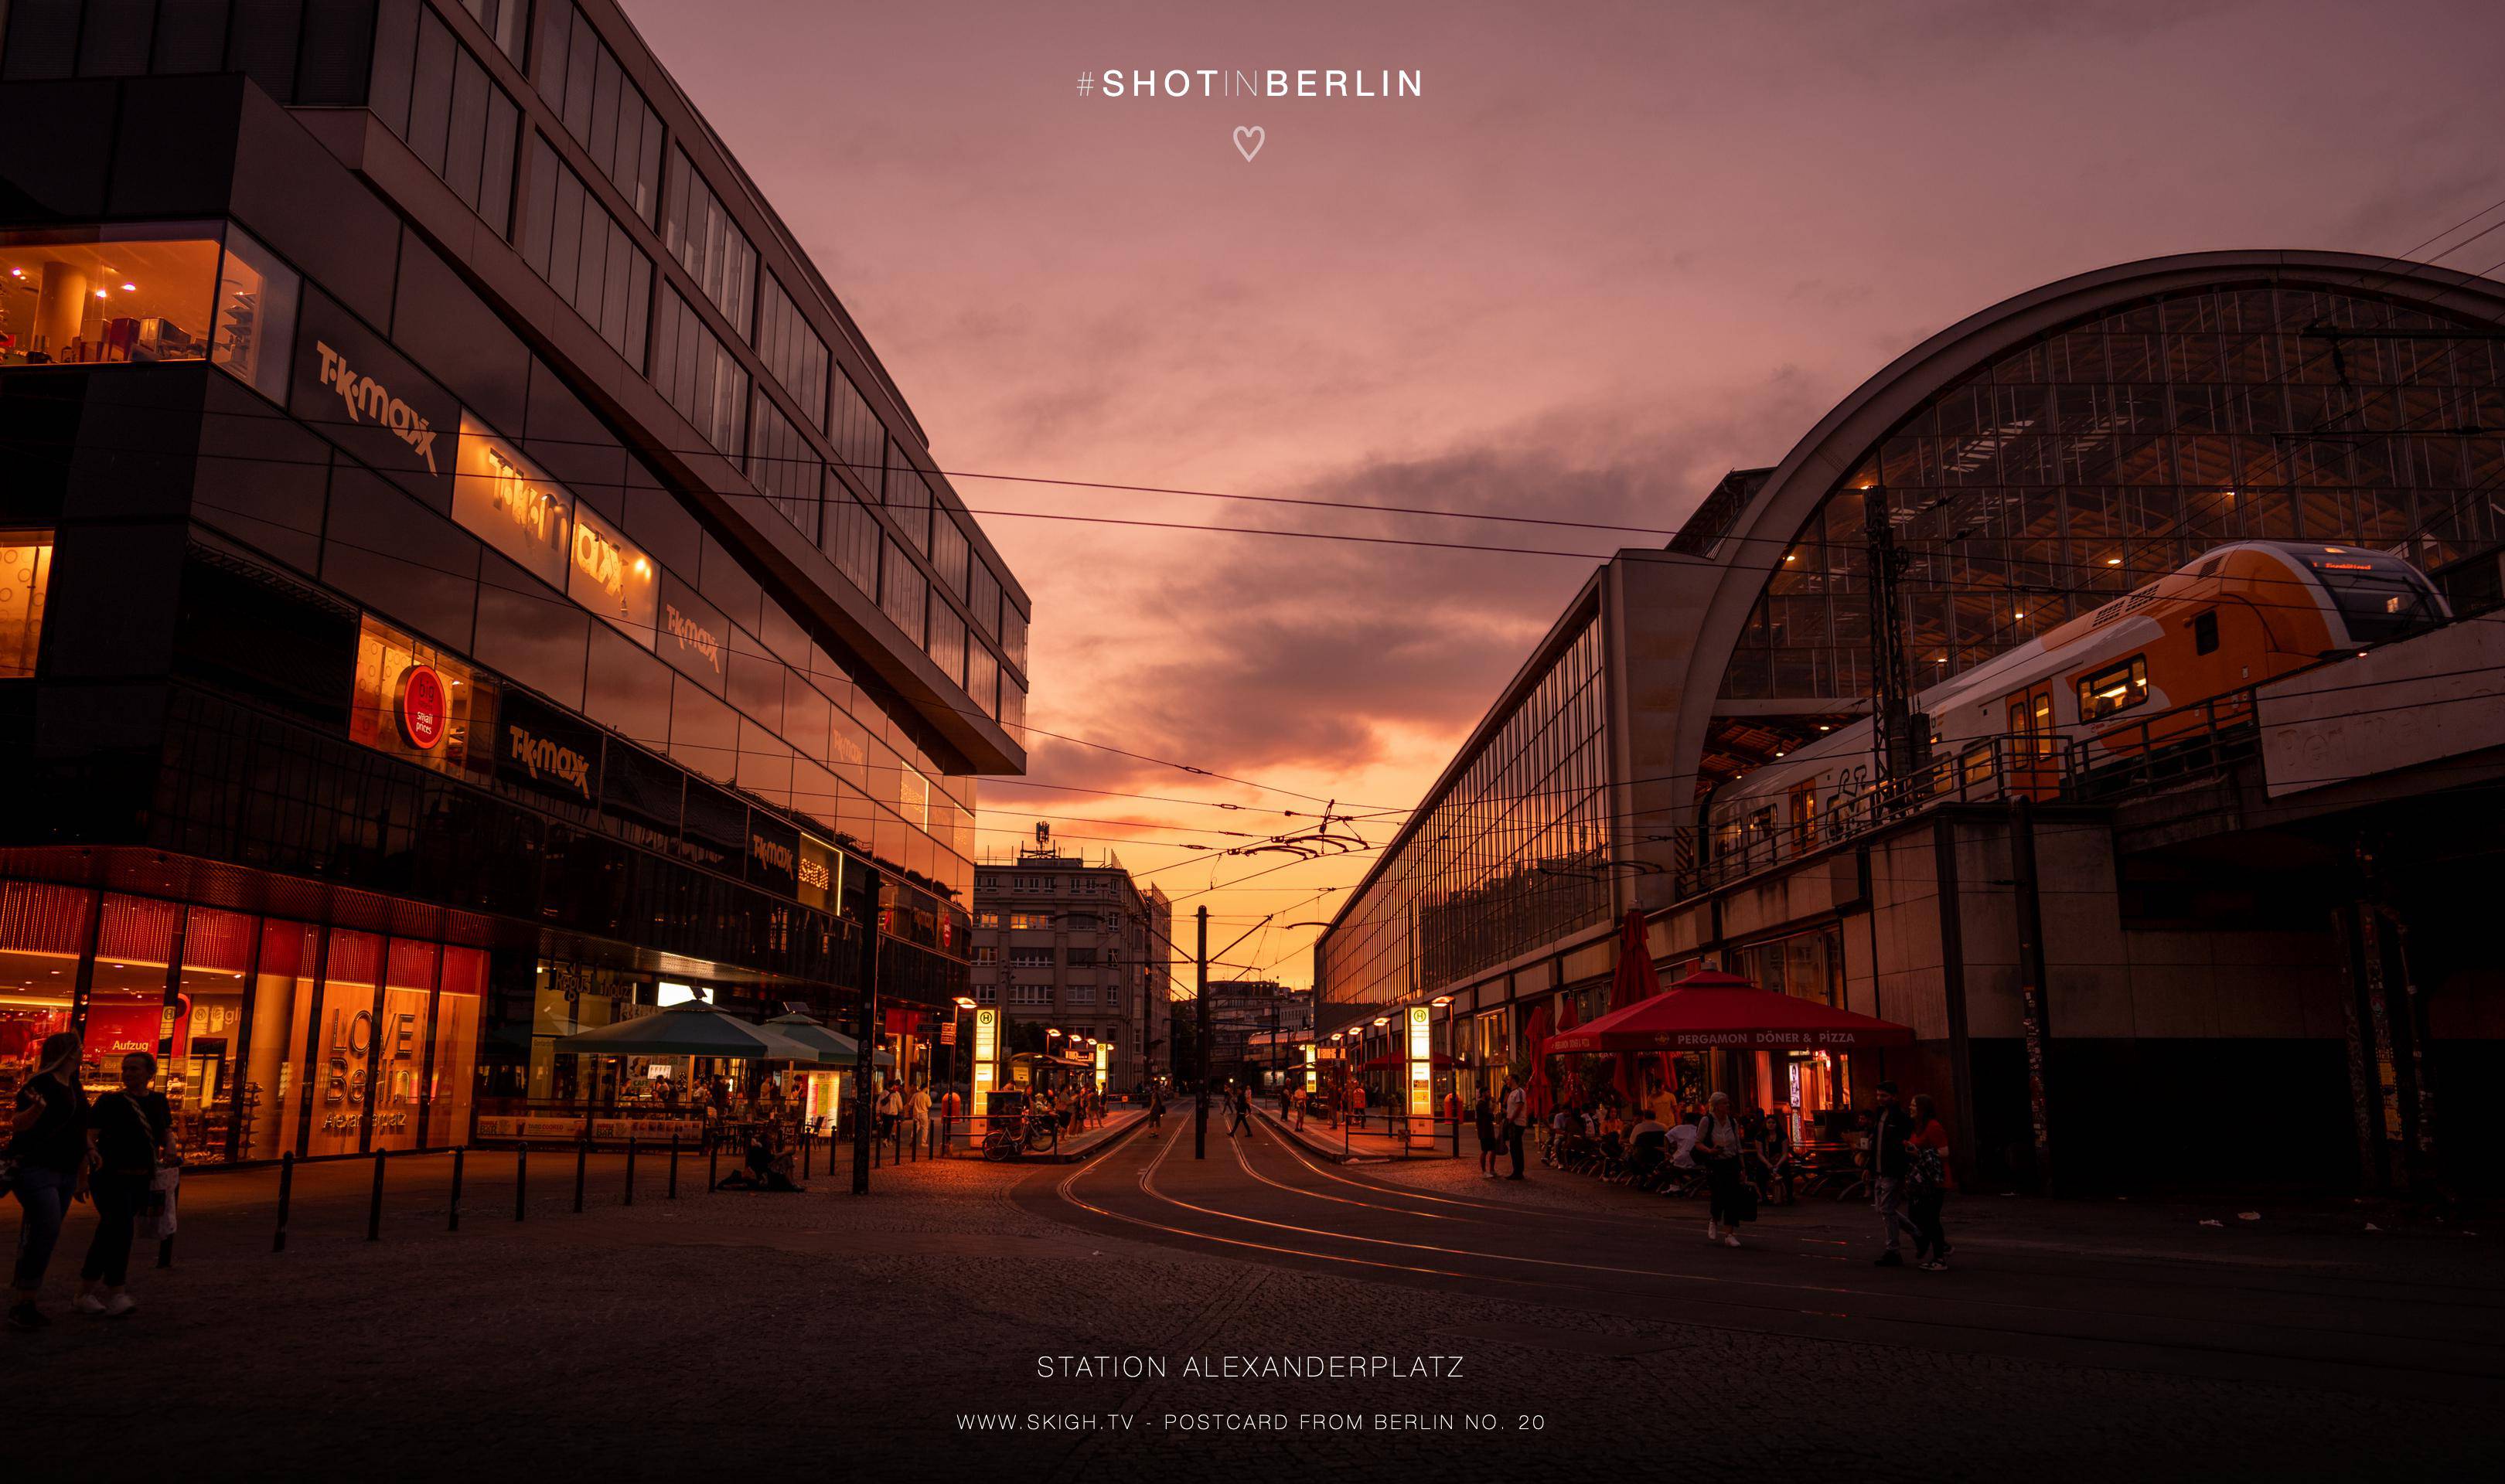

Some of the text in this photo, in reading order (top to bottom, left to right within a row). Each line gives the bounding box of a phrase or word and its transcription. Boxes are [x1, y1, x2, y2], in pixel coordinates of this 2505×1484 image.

[417, 711, 433, 725] small
[415, 722, 432, 735] prices
[1677, 1033, 1747, 1044] PERGAMON
[1756, 1030, 1799, 1043] DÖNER
[1802, 1033, 1812, 1043] &
[112, 1040, 149, 1052] Aufzug
[328, 1058, 411, 1101] Belin
